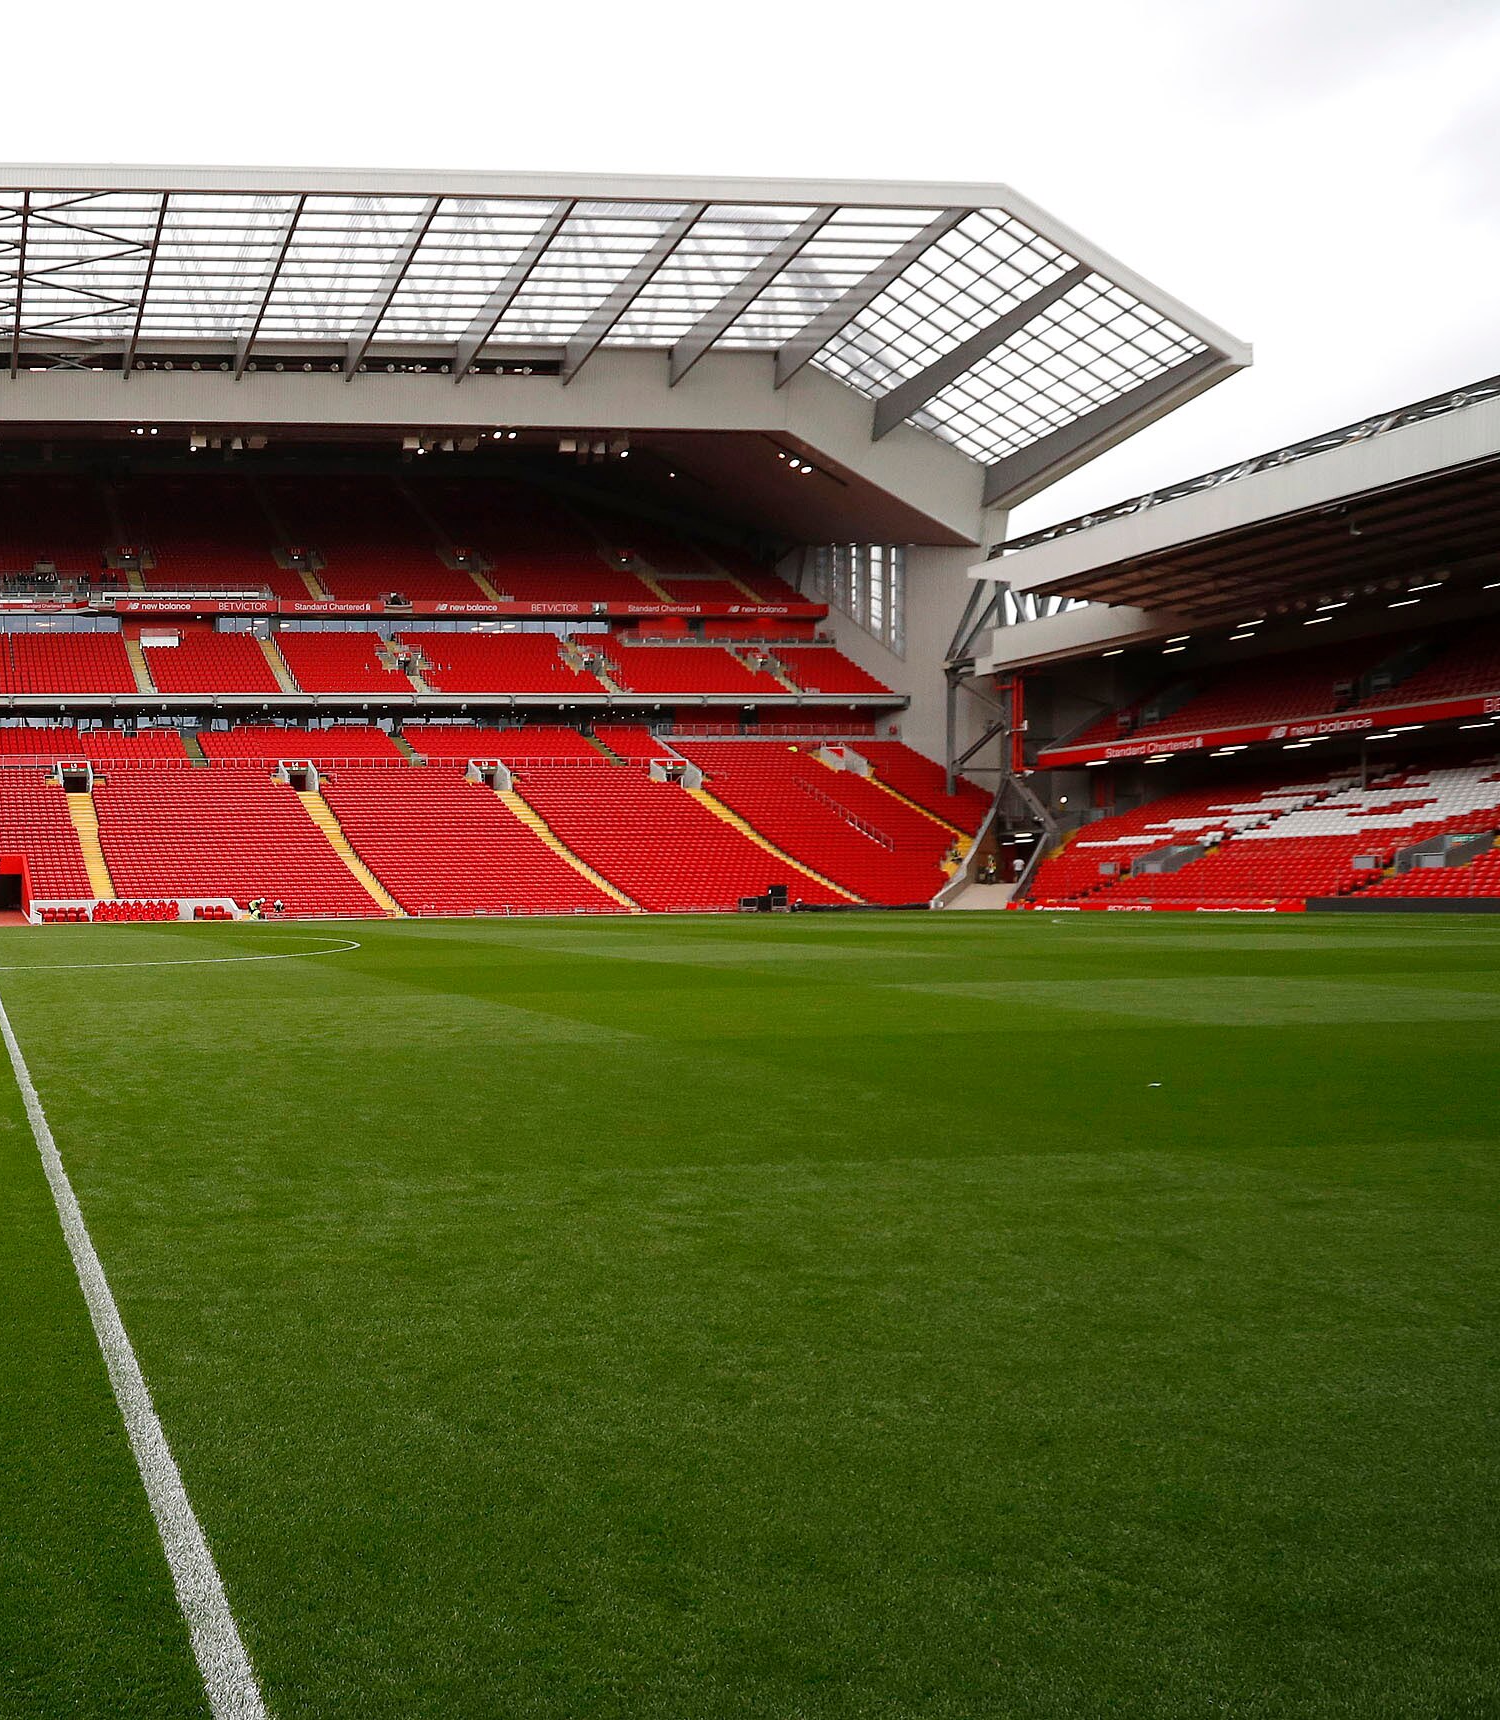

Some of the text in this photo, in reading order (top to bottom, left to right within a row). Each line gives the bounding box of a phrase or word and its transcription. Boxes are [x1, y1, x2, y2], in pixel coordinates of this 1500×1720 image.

[294, 603, 365, 611] Standard Chartered
[466, 604, 498, 612] balance
[628, 604, 695, 613] Standard Chartered
[758, 605, 788, 613] balance
[1290, 724, 1316, 736] new
[1318, 718, 1373, 734] balance
[1105, 739, 1195, 758] Standard Chartered
